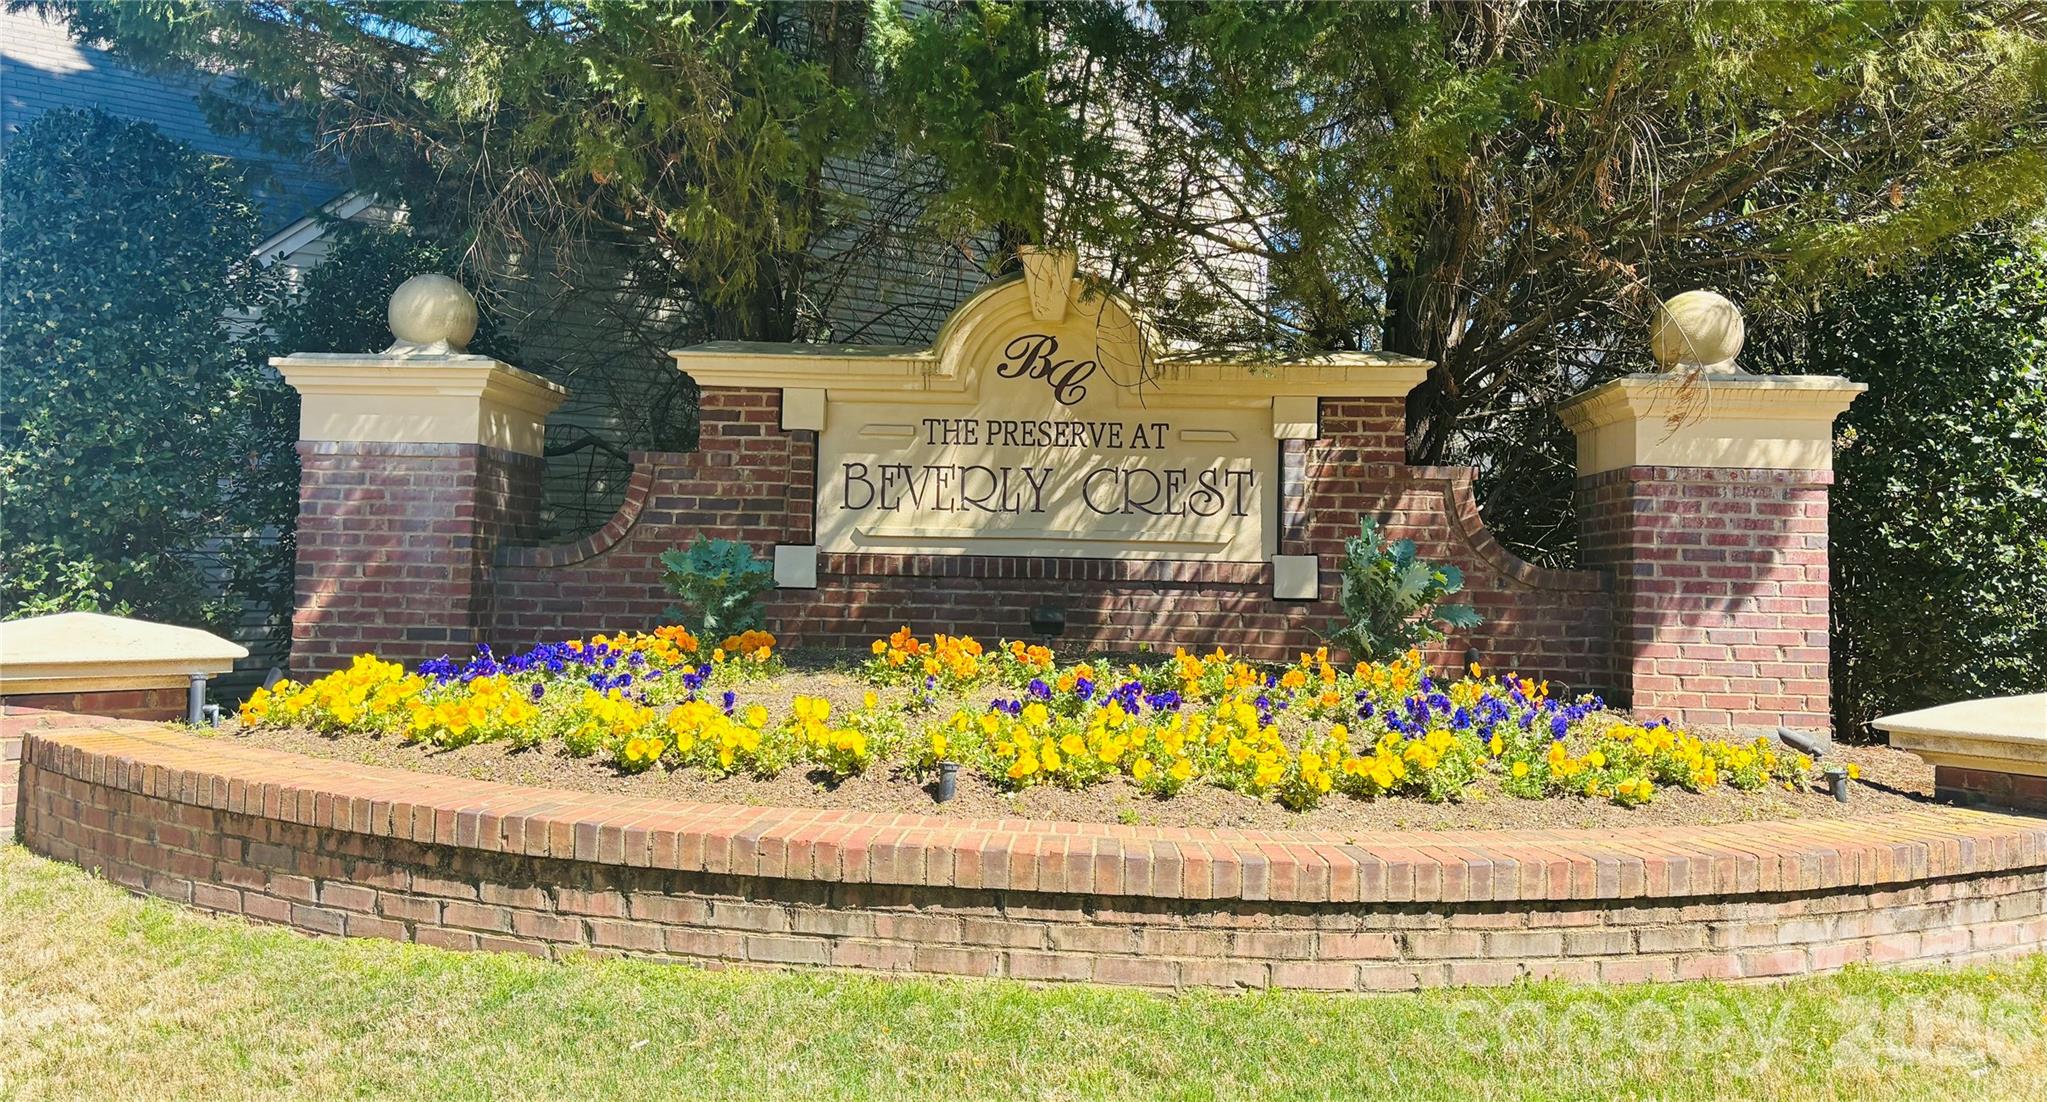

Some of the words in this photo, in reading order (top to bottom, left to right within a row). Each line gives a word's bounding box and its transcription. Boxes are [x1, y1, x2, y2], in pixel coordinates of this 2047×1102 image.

[922, 418, 979, 445] THE
[986, 420, 1123, 448] PRESERVE
[1129, 423, 1170, 449] AT
[839, 462, 1054, 514] BEVERLY
[1082, 466, 1255, 518] CREST
